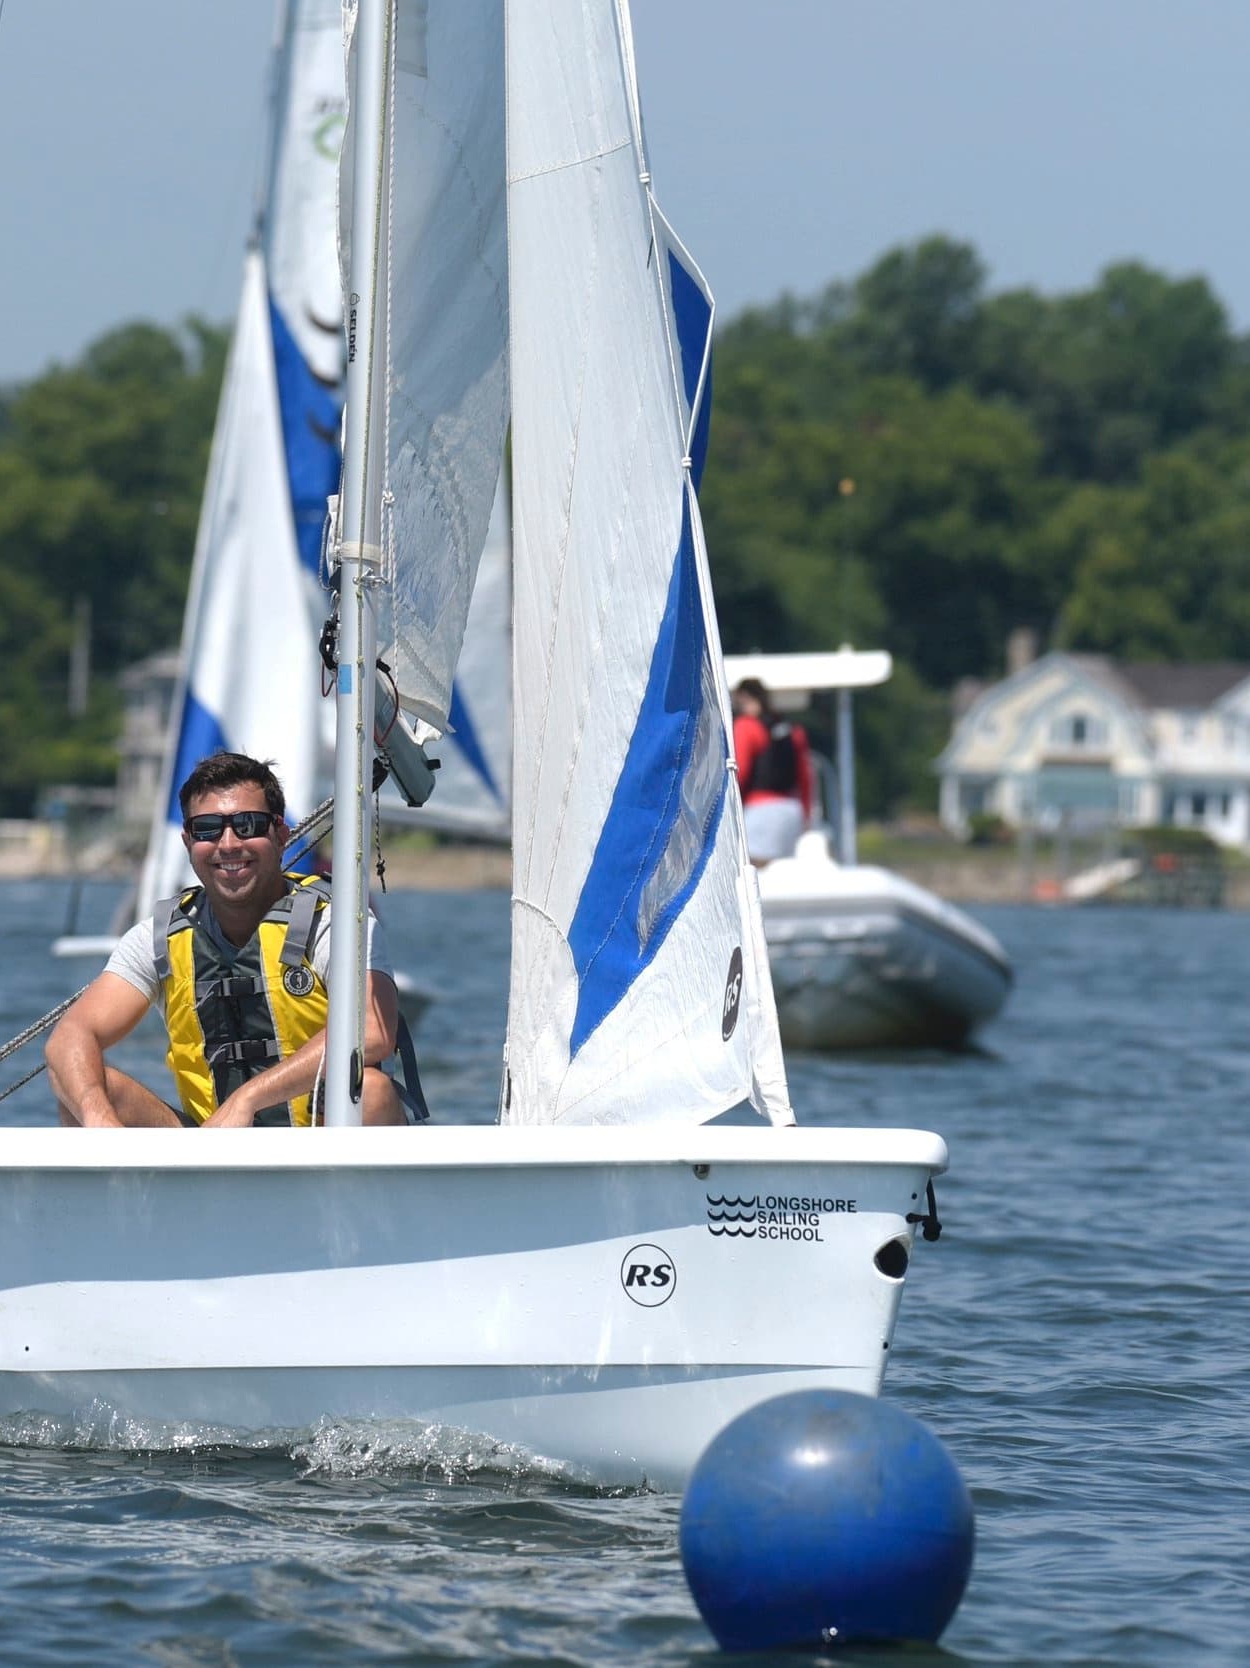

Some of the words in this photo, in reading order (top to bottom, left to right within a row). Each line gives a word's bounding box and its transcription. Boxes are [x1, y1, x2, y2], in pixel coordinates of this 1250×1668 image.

[724, 973, 741, 1017] RS
[756, 1195, 857, 1213] LONGSHORE
[757, 1211, 820, 1226] SAILING
[758, 1226, 824, 1242] SCHOOL
[625, 1264, 672, 1287] RS
